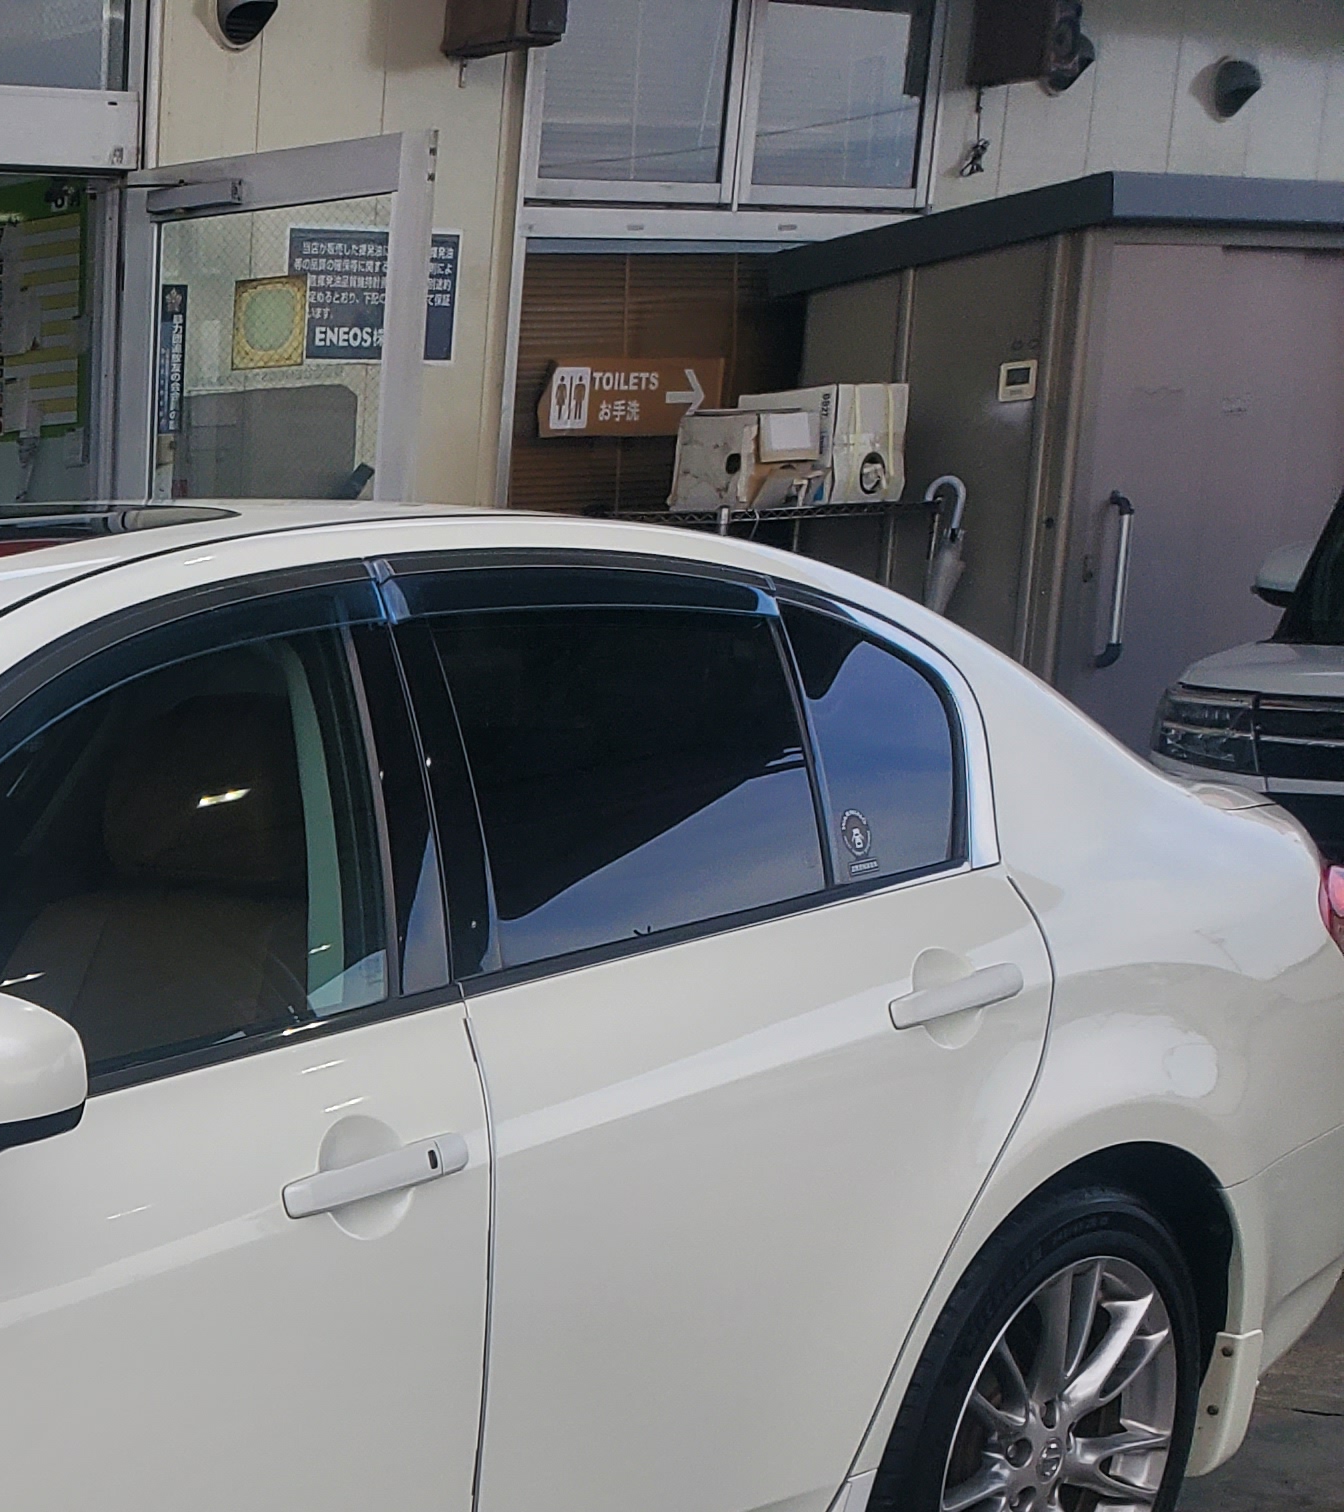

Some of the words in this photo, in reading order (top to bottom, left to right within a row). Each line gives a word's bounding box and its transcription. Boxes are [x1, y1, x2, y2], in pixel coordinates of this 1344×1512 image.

[592, 371, 659, 391] TOILETS
[598, 400, 640, 421] お手洗
